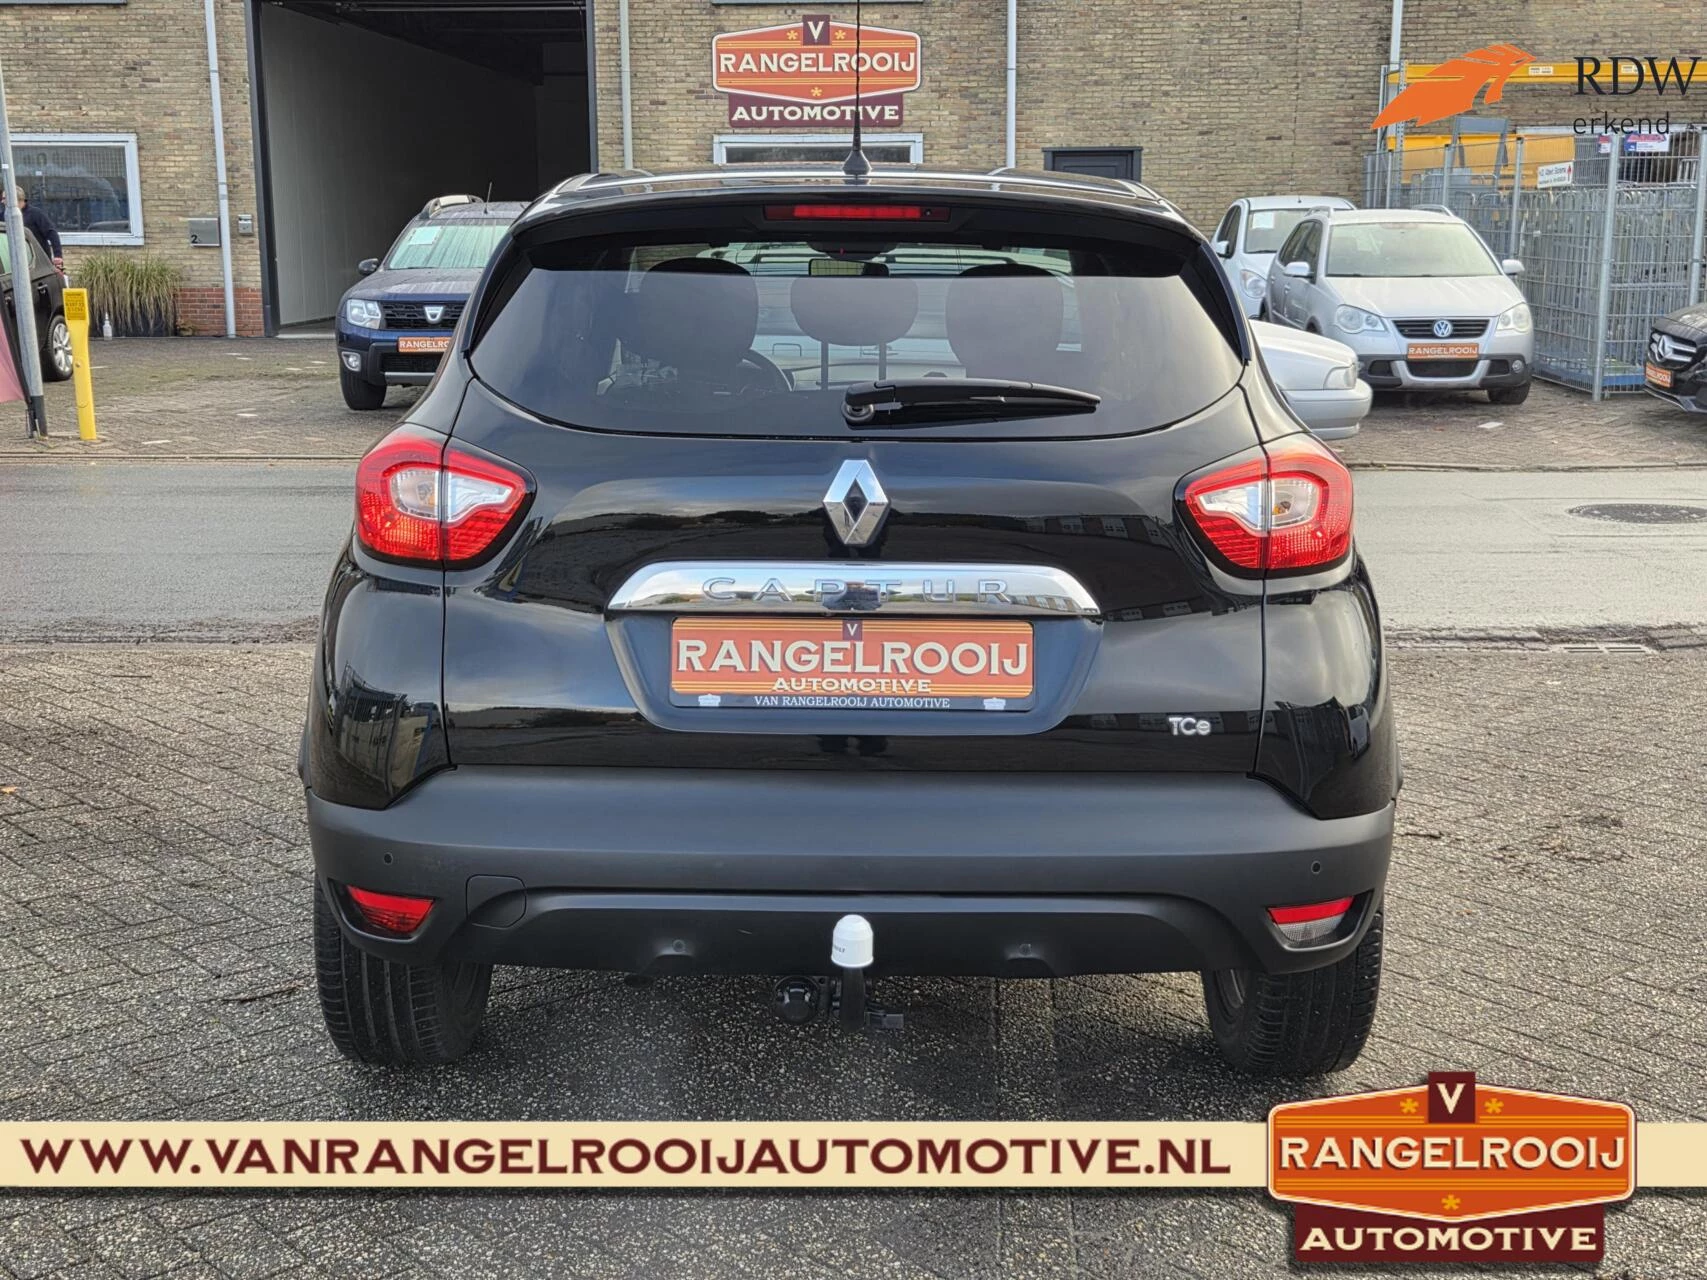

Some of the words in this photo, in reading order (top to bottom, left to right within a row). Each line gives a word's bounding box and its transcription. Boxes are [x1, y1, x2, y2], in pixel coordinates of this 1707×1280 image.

[807, 21, 824, 41] V
[719, 52, 915, 73] RANGELROOIJ
[731, 105, 899, 121] AUTOMOTIVE
[1408, 347, 1477, 355] RANGELROOIJ
[701, 577, 1013, 602] CAPTUR
[846, 623, 859, 636] V
[677, 639, 1028, 676] RANGELROOIJ
[771, 677, 931, 693] AUTOMOTIVE
[754, 695, 778, 706] VAN
[782, 696, 867, 707] RANGELROOIJ
[870, 698, 950, 708] AUTOMOTIVE
[1168, 716, 1211, 736] TCe
